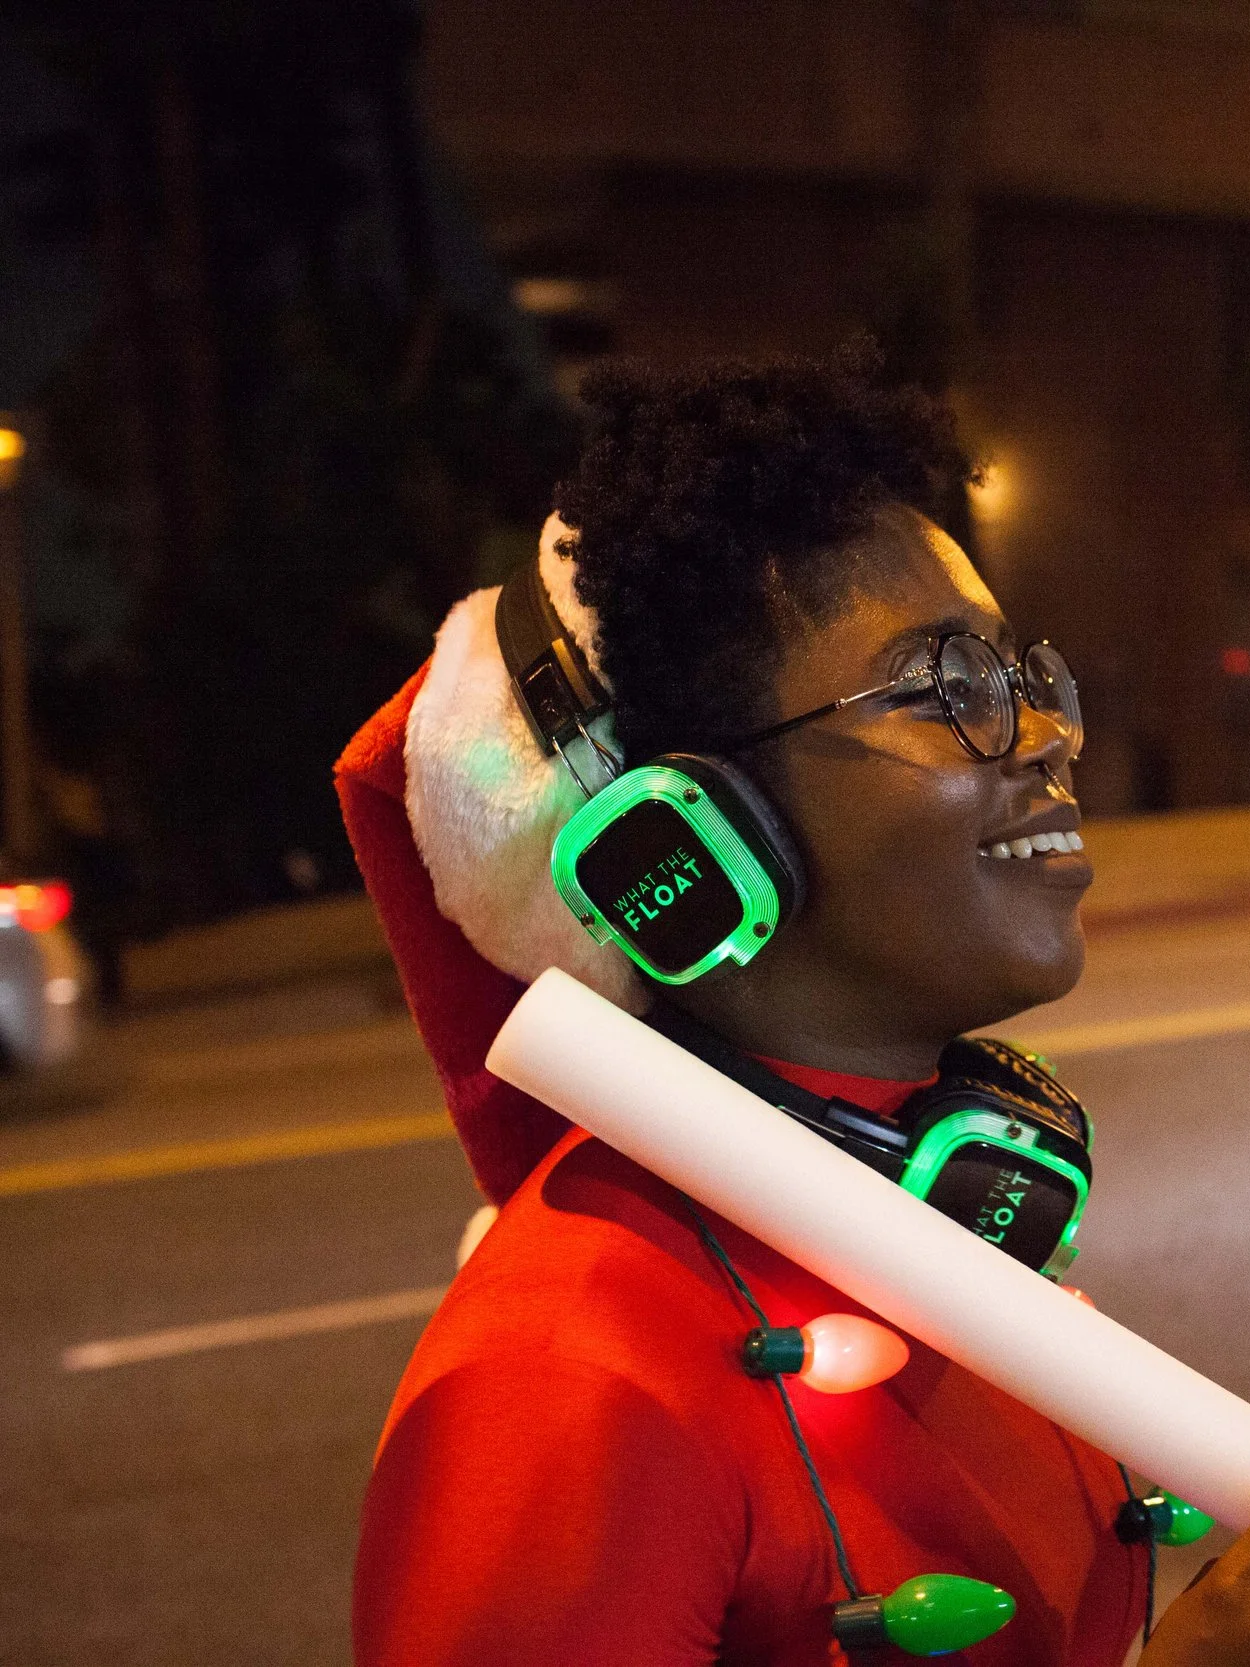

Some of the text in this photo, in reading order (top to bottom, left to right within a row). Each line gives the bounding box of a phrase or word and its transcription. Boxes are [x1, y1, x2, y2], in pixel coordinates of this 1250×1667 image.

[613, 847, 689, 912] WHAT THE
[623, 857, 703, 932] FLOAT
[973, 1169, 1013, 1235] HAT THE
[982, 1170, 1032, 1244] LOAT
